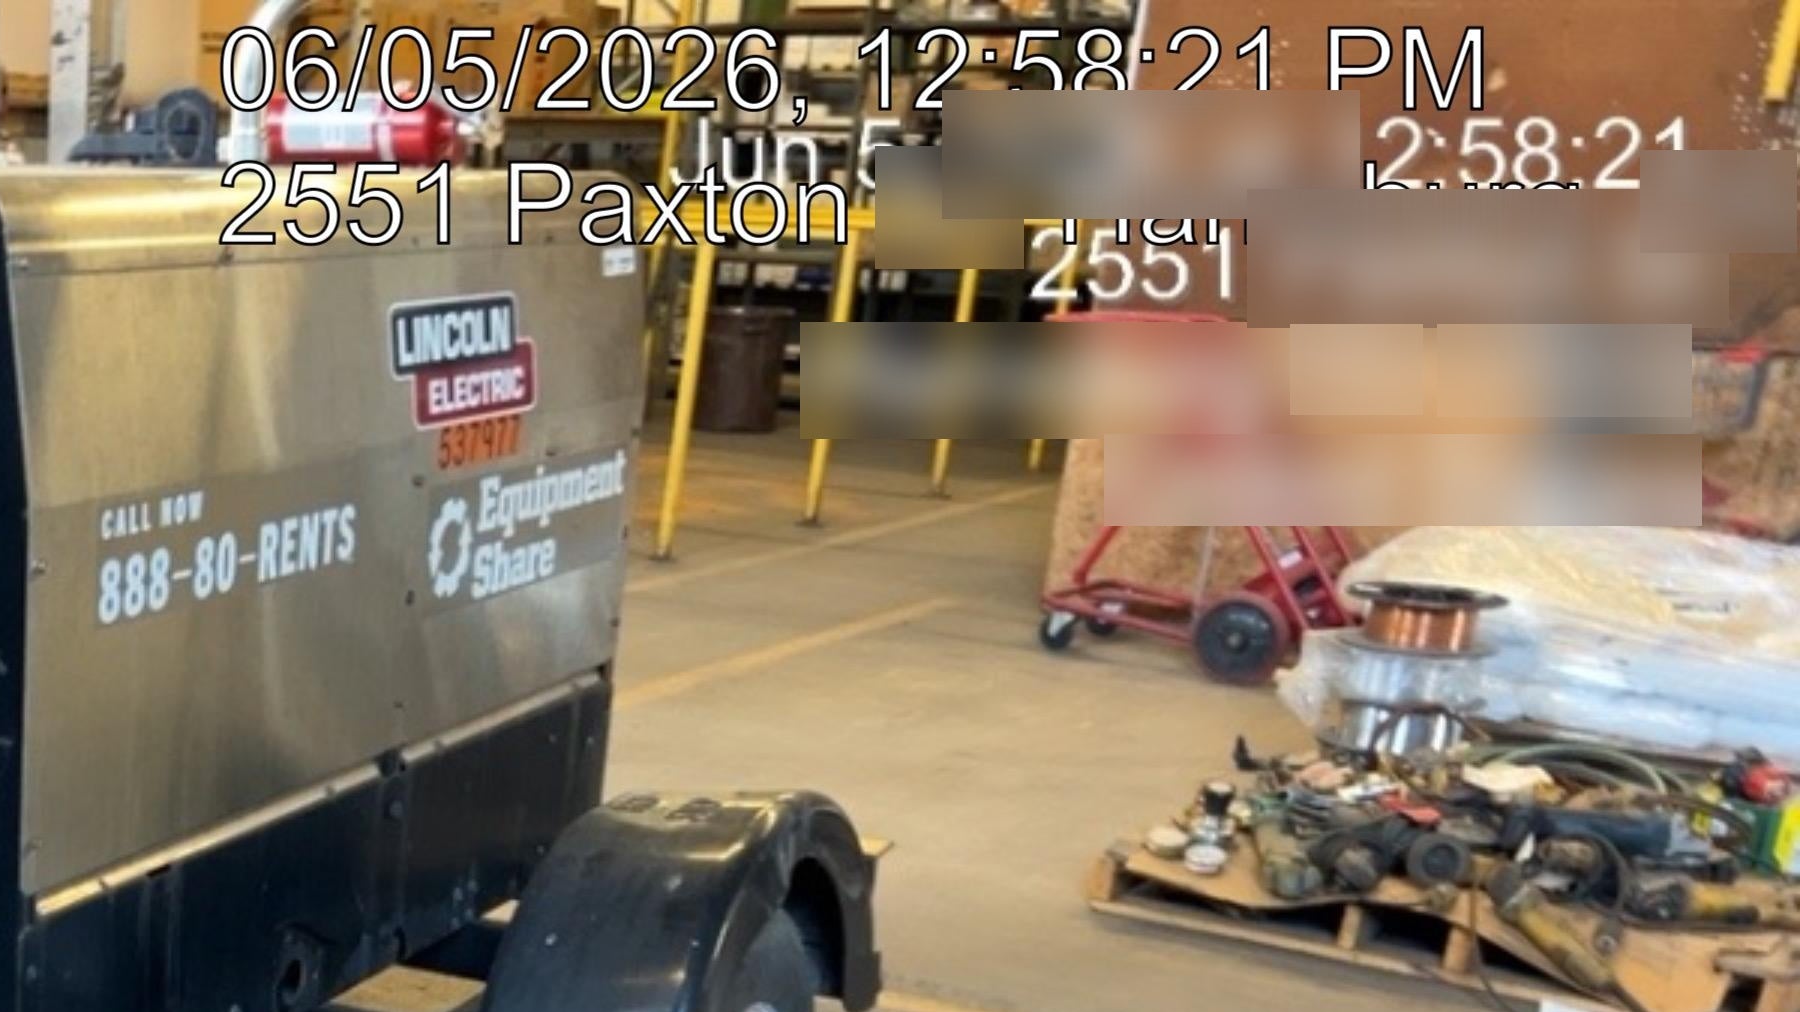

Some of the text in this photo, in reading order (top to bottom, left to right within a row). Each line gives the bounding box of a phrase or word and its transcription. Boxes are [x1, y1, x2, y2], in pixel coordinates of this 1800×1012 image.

[398, 304, 513, 367] LINCOLN
[426, 366, 526, 417] ELECTRIC
[101, 491, 205, 541] CALL NOW
[476, 449, 627, 538] Equipment
[99, 503, 358, 624] 888-80-RENTS
[470, 538, 557, 600] Share
